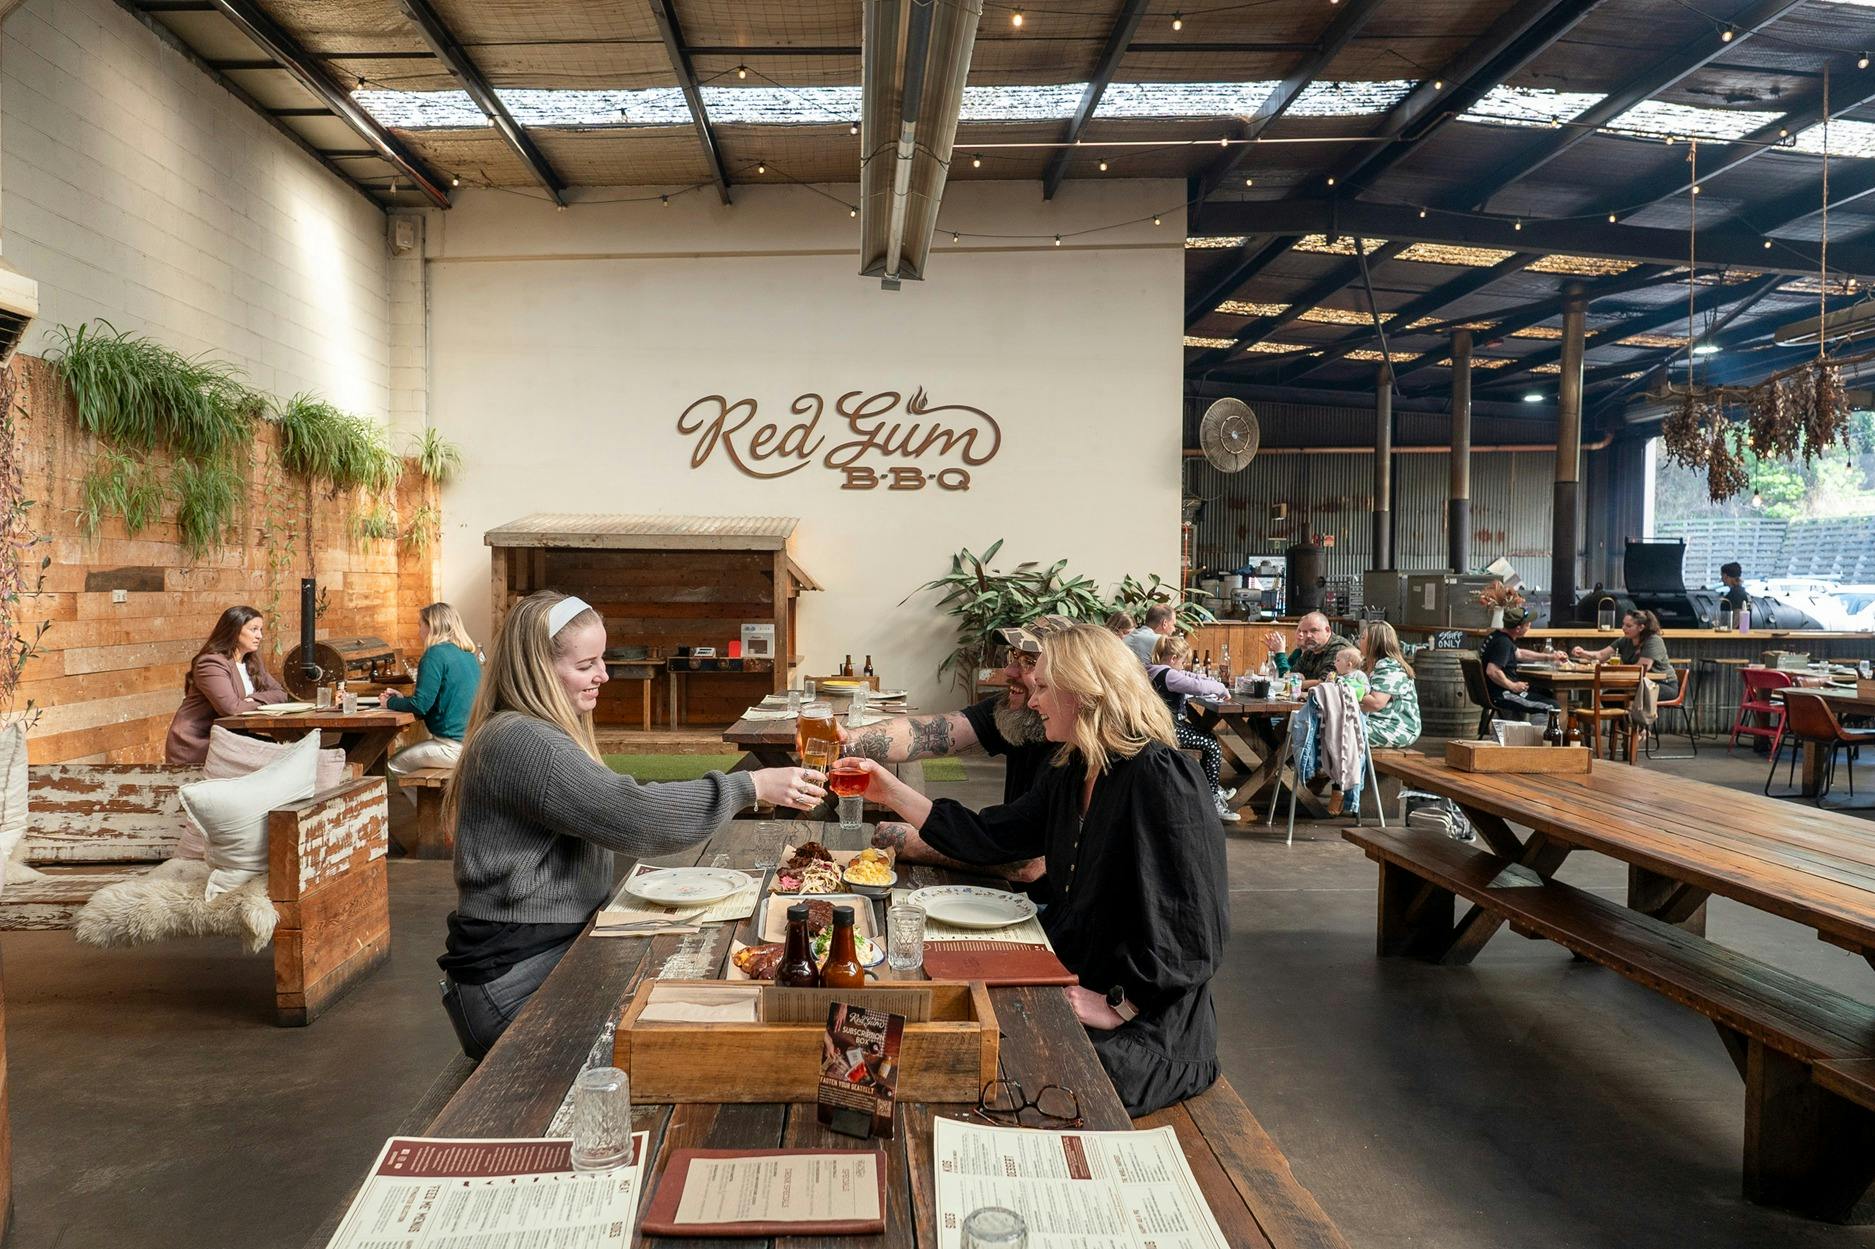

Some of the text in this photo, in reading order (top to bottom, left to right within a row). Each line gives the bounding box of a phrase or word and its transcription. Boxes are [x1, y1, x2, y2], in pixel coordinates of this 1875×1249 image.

[677, 390, 1001, 479] Red Gum
[1438, 631, 1463, 640] STAFF
[1438, 640, 1461, 649] ONLY
[849, 1012, 885, 1029] Red Gum
[842, 1025, 885, 1041] SUBSCRIPTION
[855, 1036, 869, 1045] BOX
[1003, 1154, 1018, 1178] DESSERT
